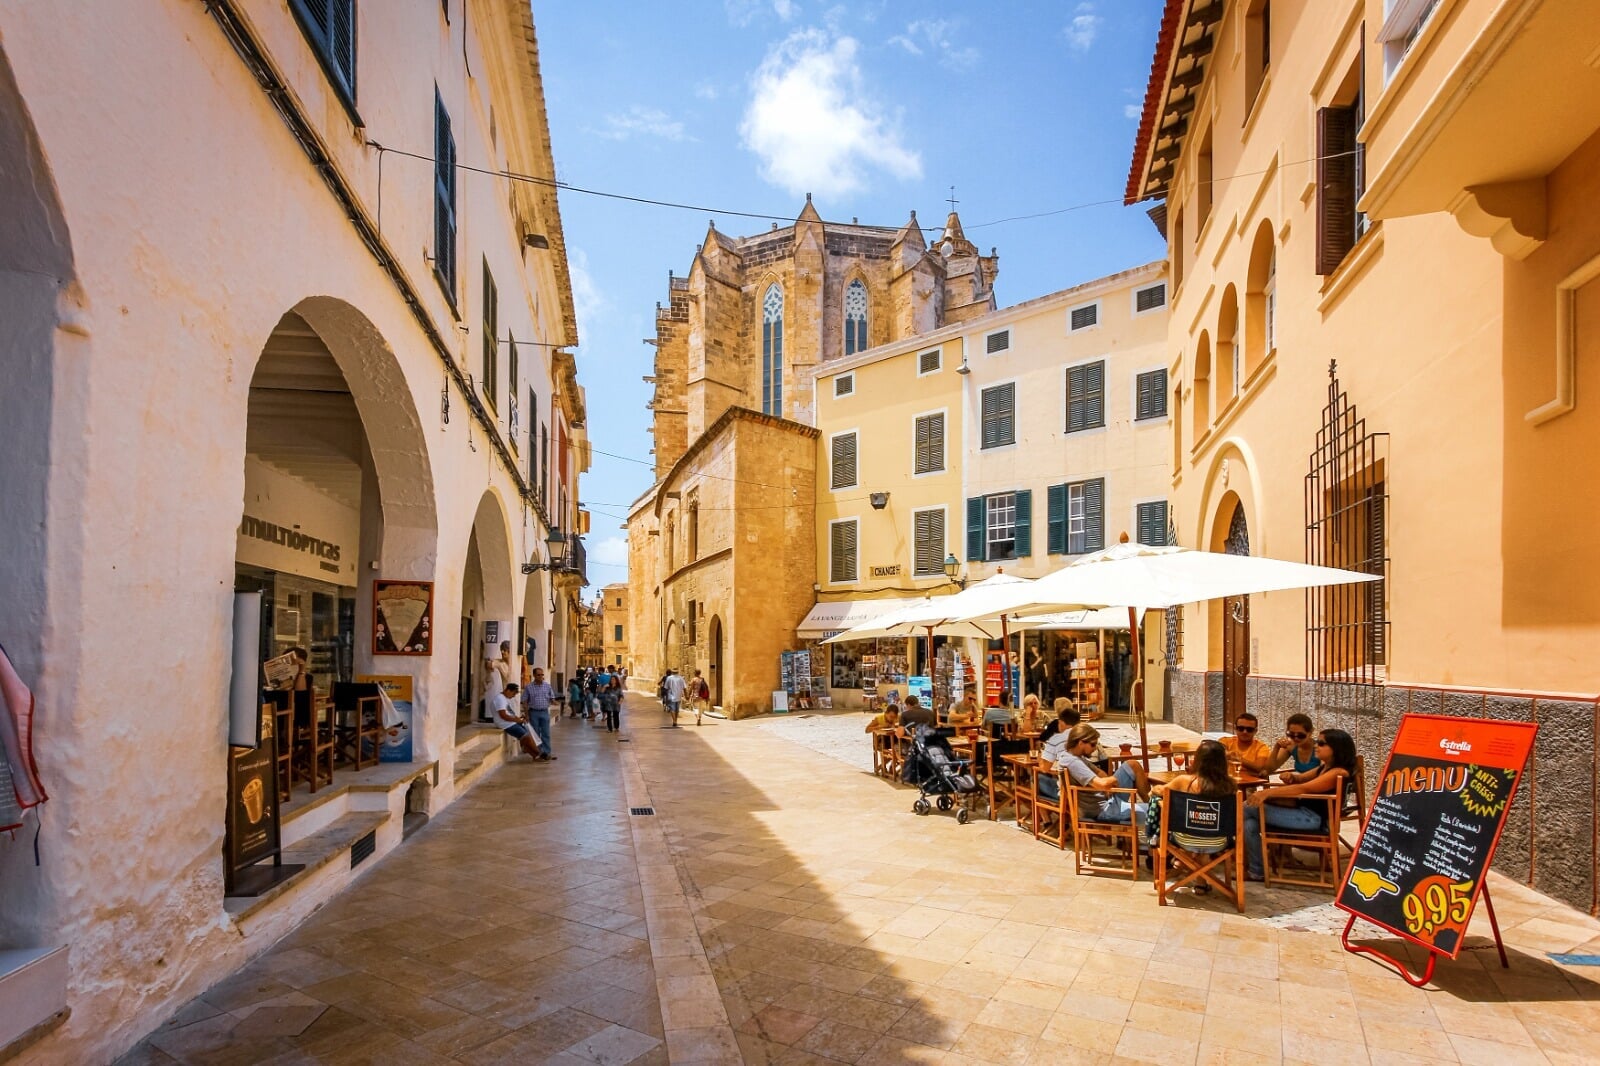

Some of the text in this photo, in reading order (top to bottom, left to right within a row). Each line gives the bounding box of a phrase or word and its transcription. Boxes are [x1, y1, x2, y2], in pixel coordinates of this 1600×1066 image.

[874, 566, 896, 576] CHANGE
[486, 634, 497, 642] 97
[1440, 738, 1472, 752] Estrella
[1189, 811, 1217, 821] MOSSETS
[1402, 880, 1474, 935] 9,95
